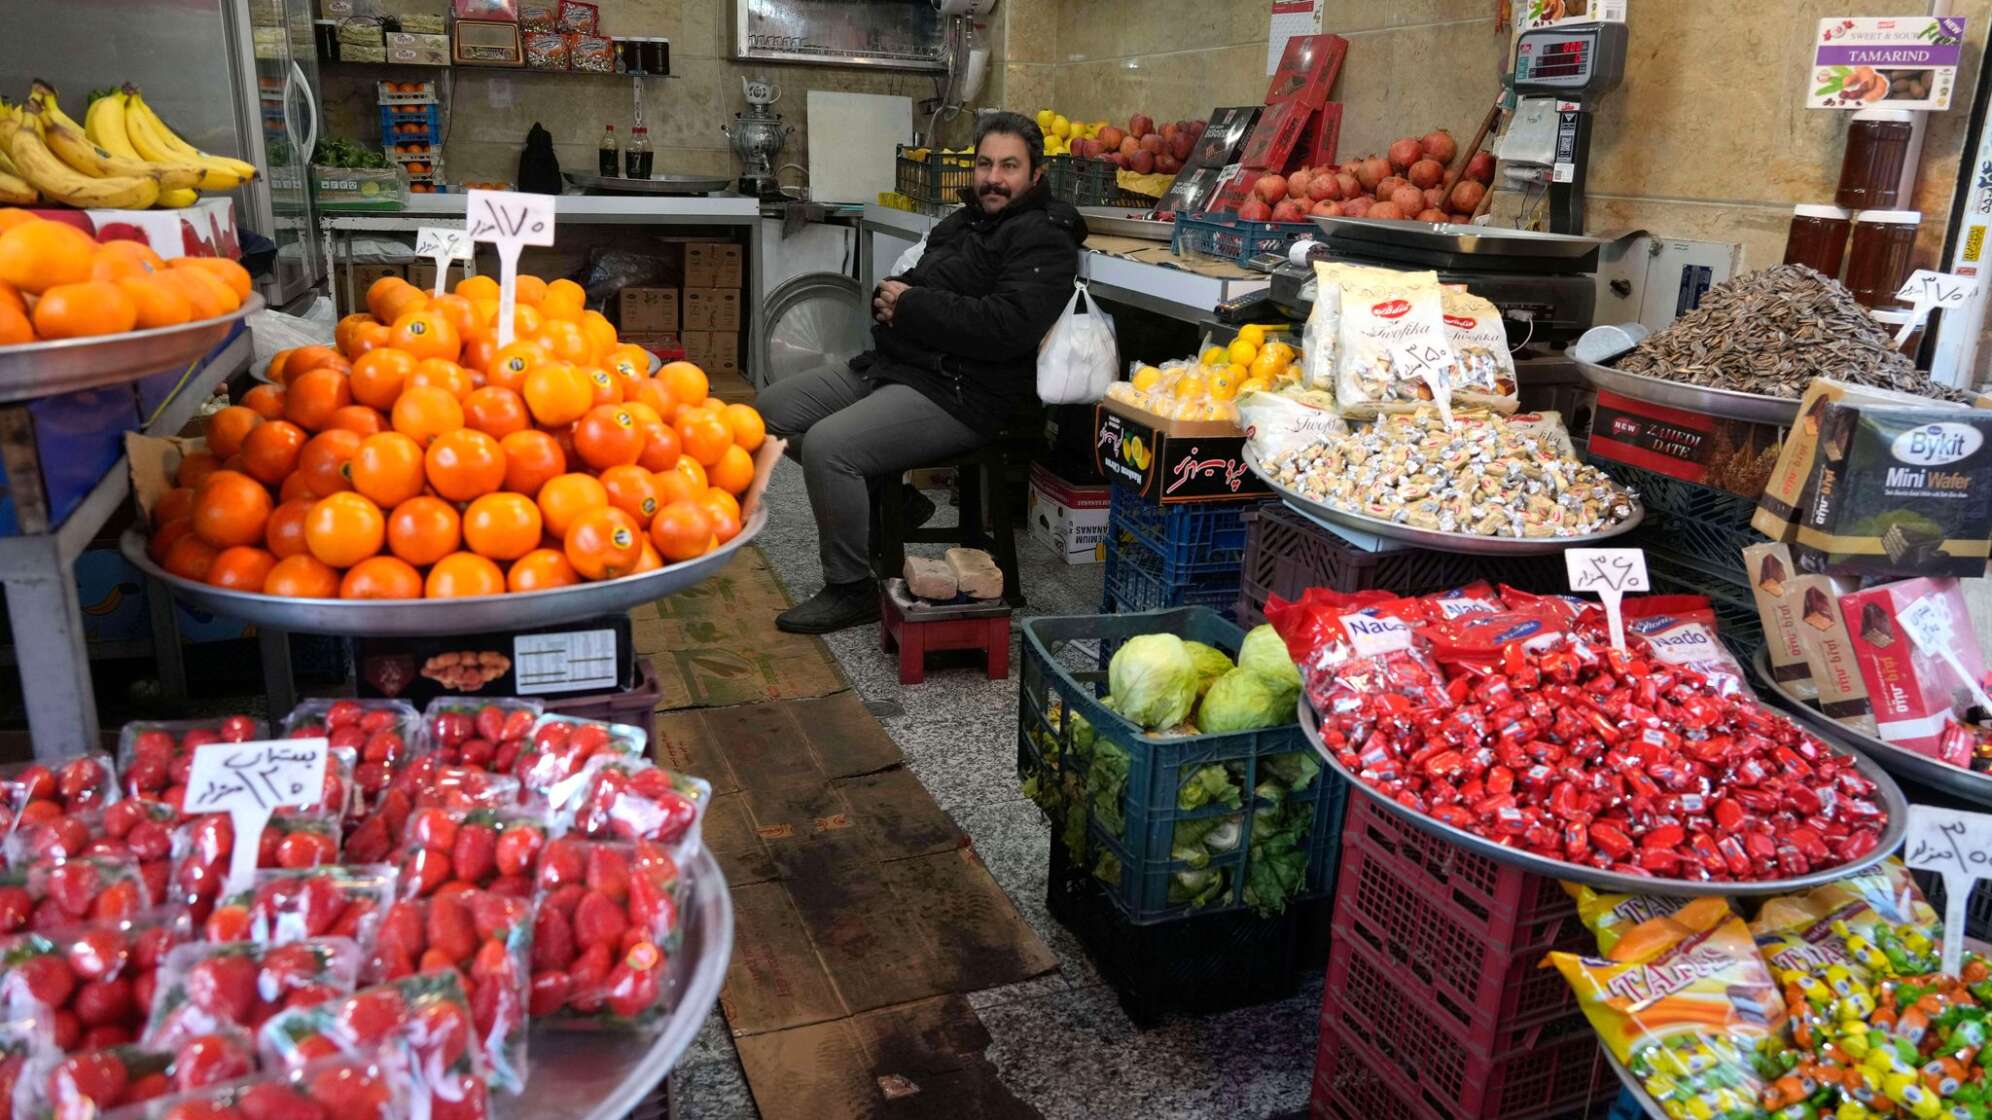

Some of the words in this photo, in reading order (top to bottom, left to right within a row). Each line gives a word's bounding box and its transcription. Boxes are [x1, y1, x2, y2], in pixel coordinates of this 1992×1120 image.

[1850, 31, 1882, 40] SWEET
[1848, 50, 1930, 62] TAMARIND
[1613, 421, 1637, 433] NEW
[1646, 423, 1703, 448] ZAHEDI
[1652, 438, 1691, 459] DATE
[1909, 431, 1965, 461] Bykit
[1885, 467, 1927, 489] Mini
[1928, 472, 1970, 490] Wafer
[1938, 820, 1992, 874] ۳۰
